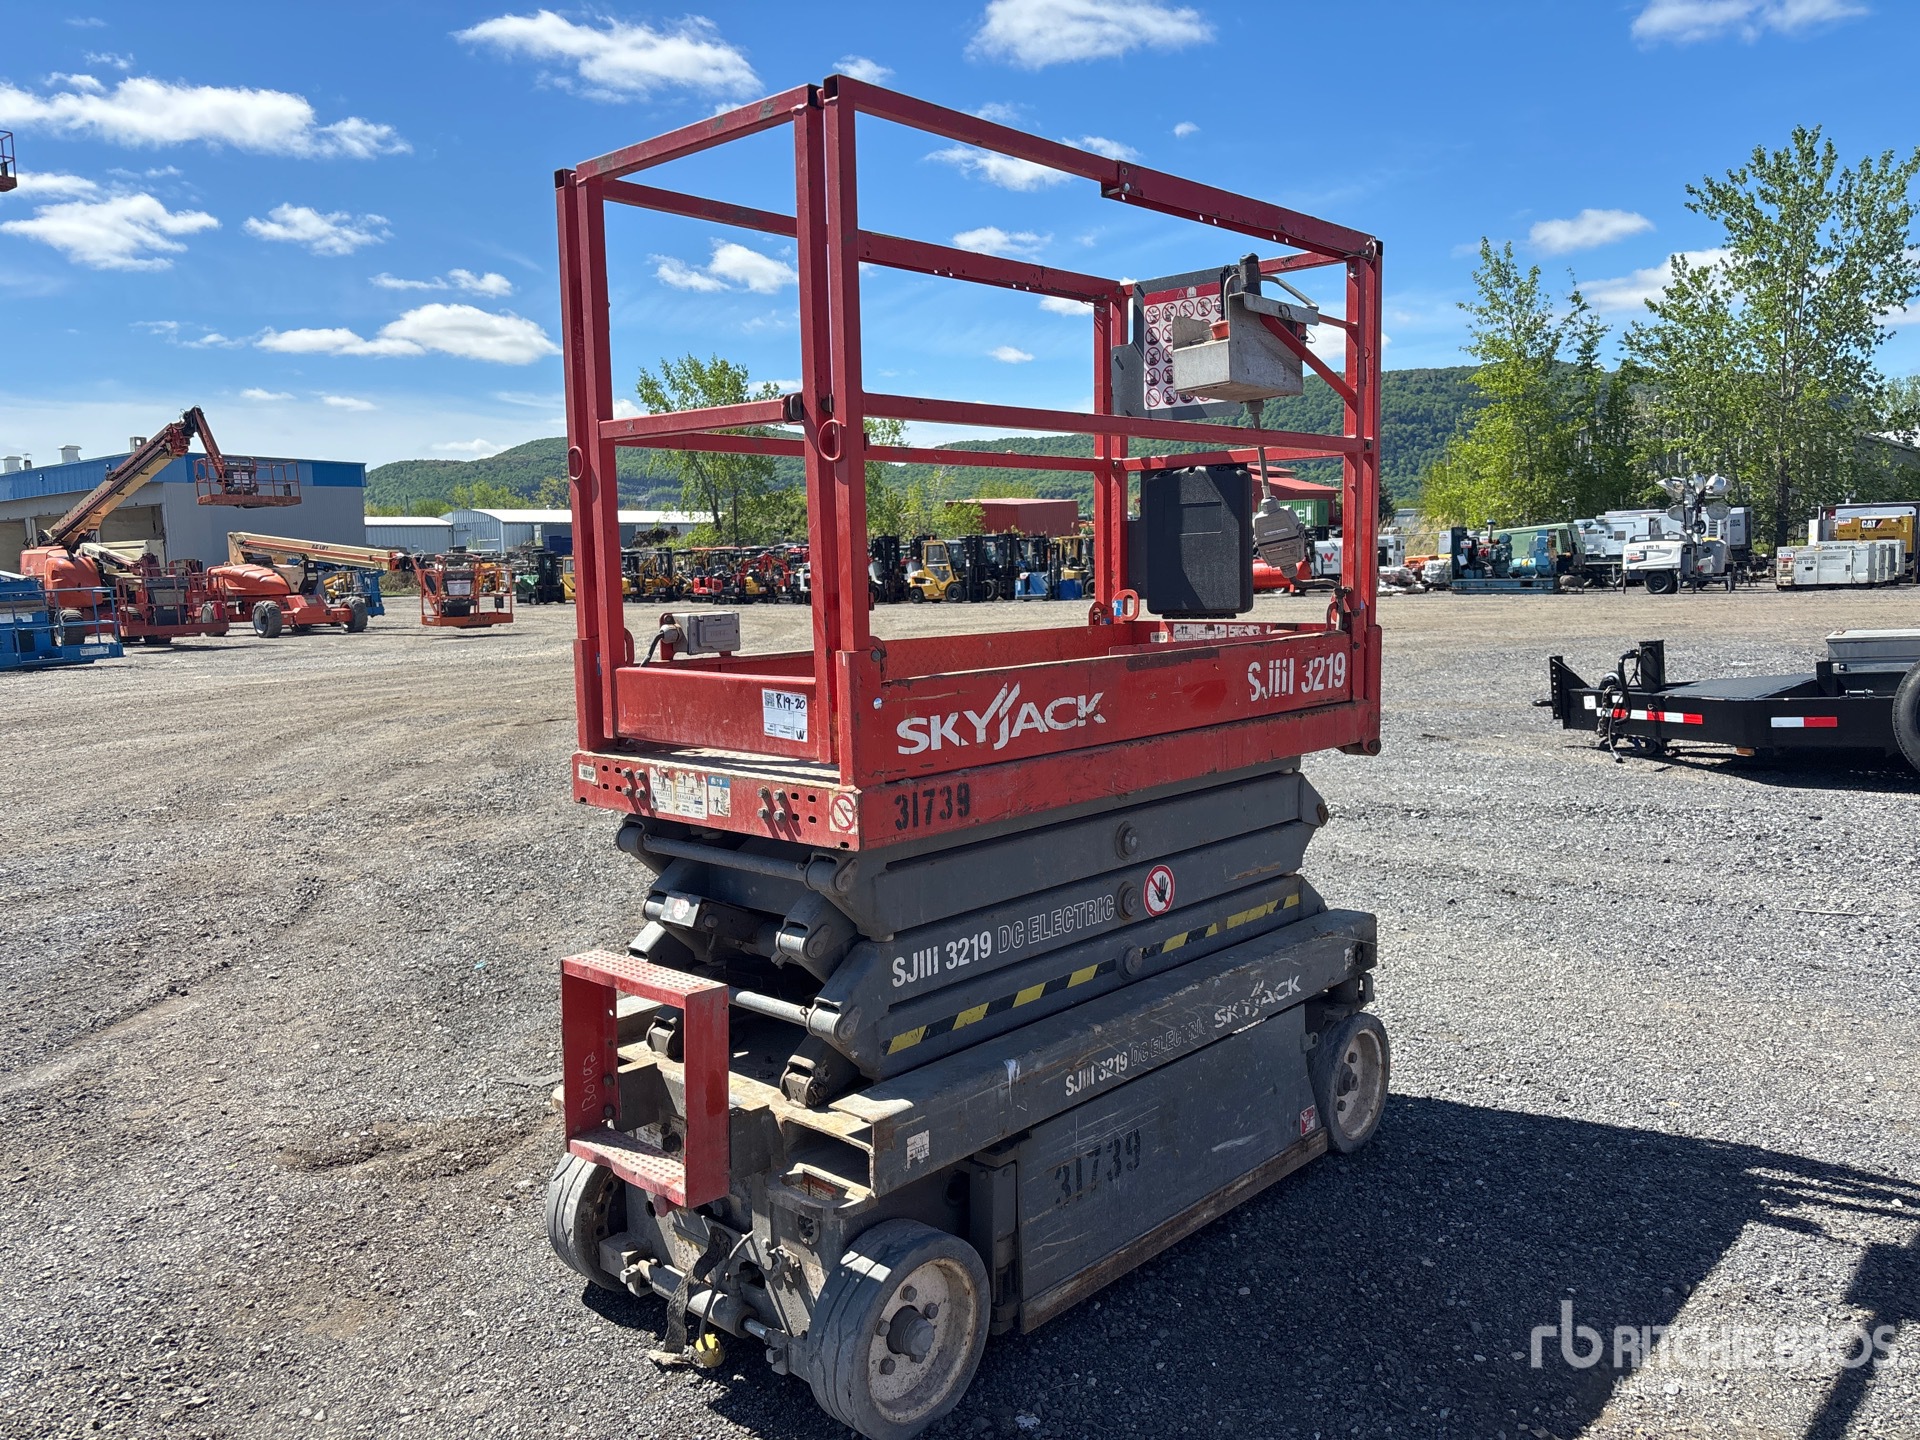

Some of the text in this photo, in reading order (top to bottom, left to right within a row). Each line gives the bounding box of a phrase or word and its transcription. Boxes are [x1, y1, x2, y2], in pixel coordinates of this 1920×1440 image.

[1861, 519, 1877, 528] CAT
[1300, 651, 1346, 694] 3219
[775, 693, 806, 711] R19-20
[896, 681, 1107, 755] SKYJACK
[795, 729, 806, 740] W
[894, 782, 972, 831] 31739
[945, 930, 992, 971] 3219
[998, 920, 1025, 954] DC
[1028, 894, 1115, 945] ELECTRIC
[1098, 1052, 1128, 1082] 3219
[1214, 973, 1302, 1029] SKYJACK
[1054, 1128, 1141, 1209] 31739
